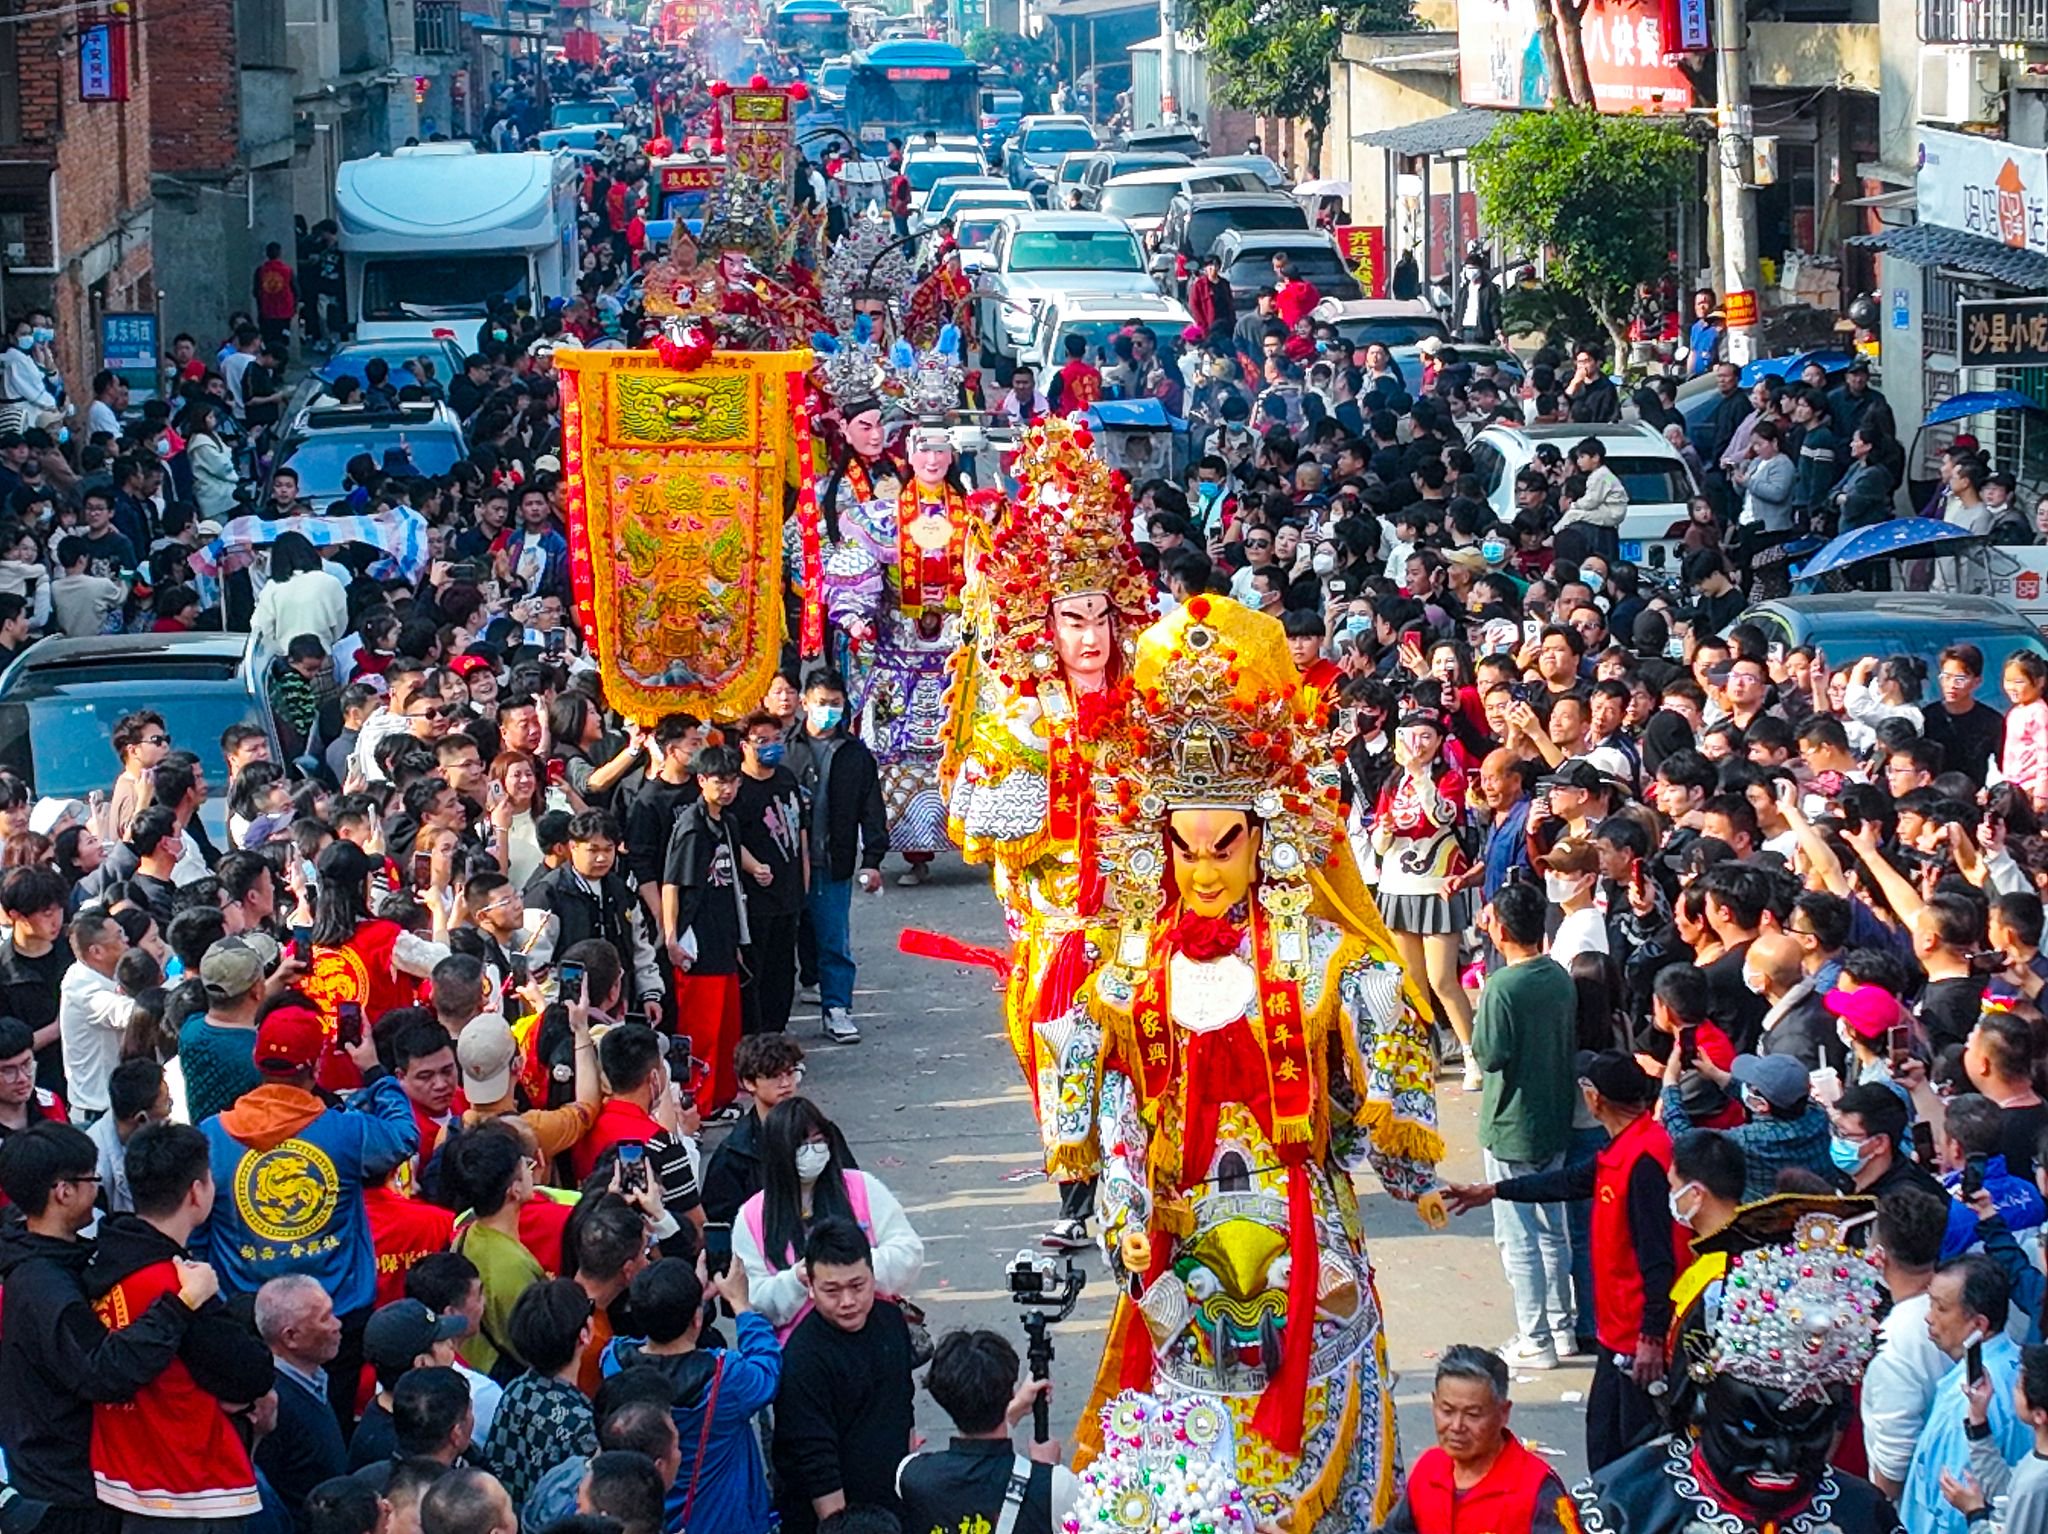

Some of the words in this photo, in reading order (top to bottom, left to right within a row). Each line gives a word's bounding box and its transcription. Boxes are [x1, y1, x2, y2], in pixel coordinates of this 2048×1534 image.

[1590, 15, 1683, 67] 八快餐
[1968, 312, 2048, 354] 沙县小吃
